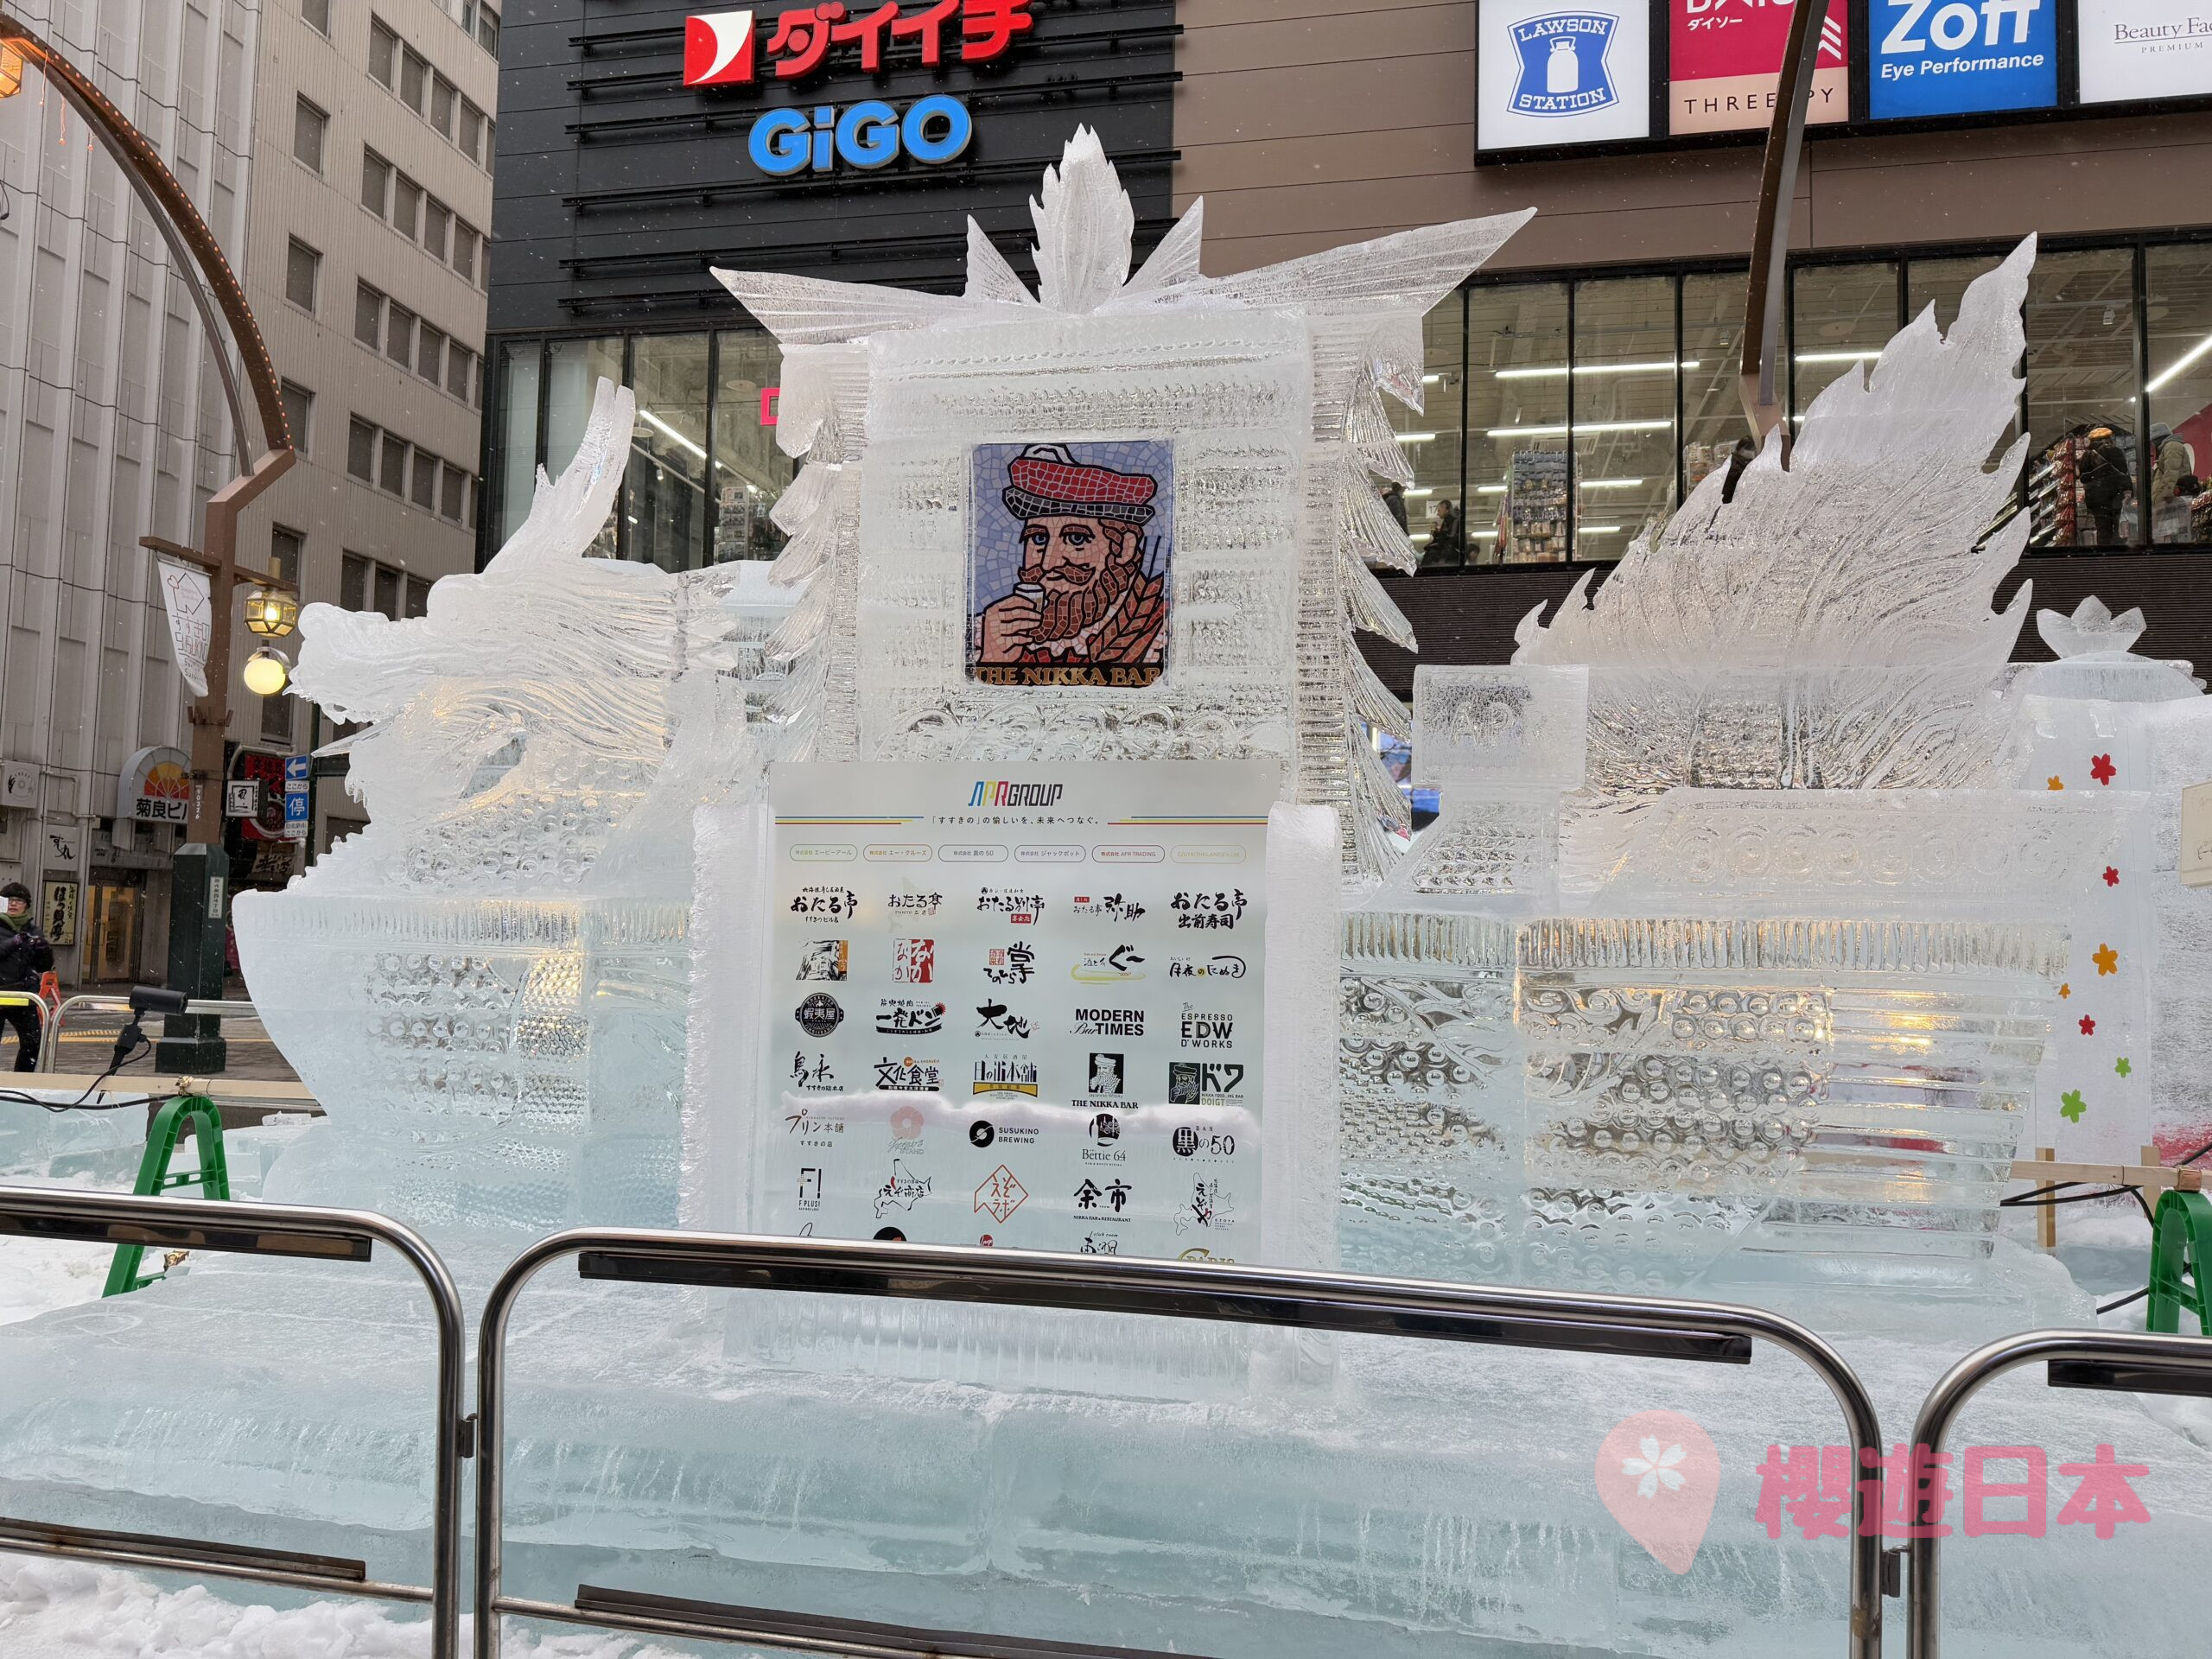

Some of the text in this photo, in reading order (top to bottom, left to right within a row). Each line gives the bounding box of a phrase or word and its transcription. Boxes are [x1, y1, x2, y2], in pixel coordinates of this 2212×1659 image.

[1518, 18, 1609, 41] LAWSON
[1687, 16, 1744, 31] ダイソー
[2113, 23, 2183, 40] Beauty
[767, 0, 1034, 79] ダイイチ
[2141, 41, 2203, 54] PREMIUM
[1880, 54, 2044, 81] Eye Performance
[1519, 87, 1607, 110] STATION
[1684, 87, 1834, 115] THREEY
[748, 93, 973, 175] GiGO
[976, 666, 1161, 686] THE NIKKA BAR
[289, 797, 305, 817] 停
[790, 890, 859, 919] おたる亭
[1170, 888, 1248, 920] おたる亭
[1178, 913, 1234, 930] 出前寿司
[1075, 1008, 1145, 1023] MODERN
[1181, 1013, 1234, 1021] ESPRESSO
[1096, 1023, 1145, 1036] TIMES
[1180, 1020, 1234, 1039] EDW
[874, 1057, 940, 1087] 文化食堂
[1090, 1100, 1119, 1109] NIKKA
[785, 1109, 844, 1135] プリン本舗
[998, 1127, 1039, 1135] SUSUKINO
[1113, 1150, 1127, 1161] 64
[1073, 1179, 1133, 1212] 余市
